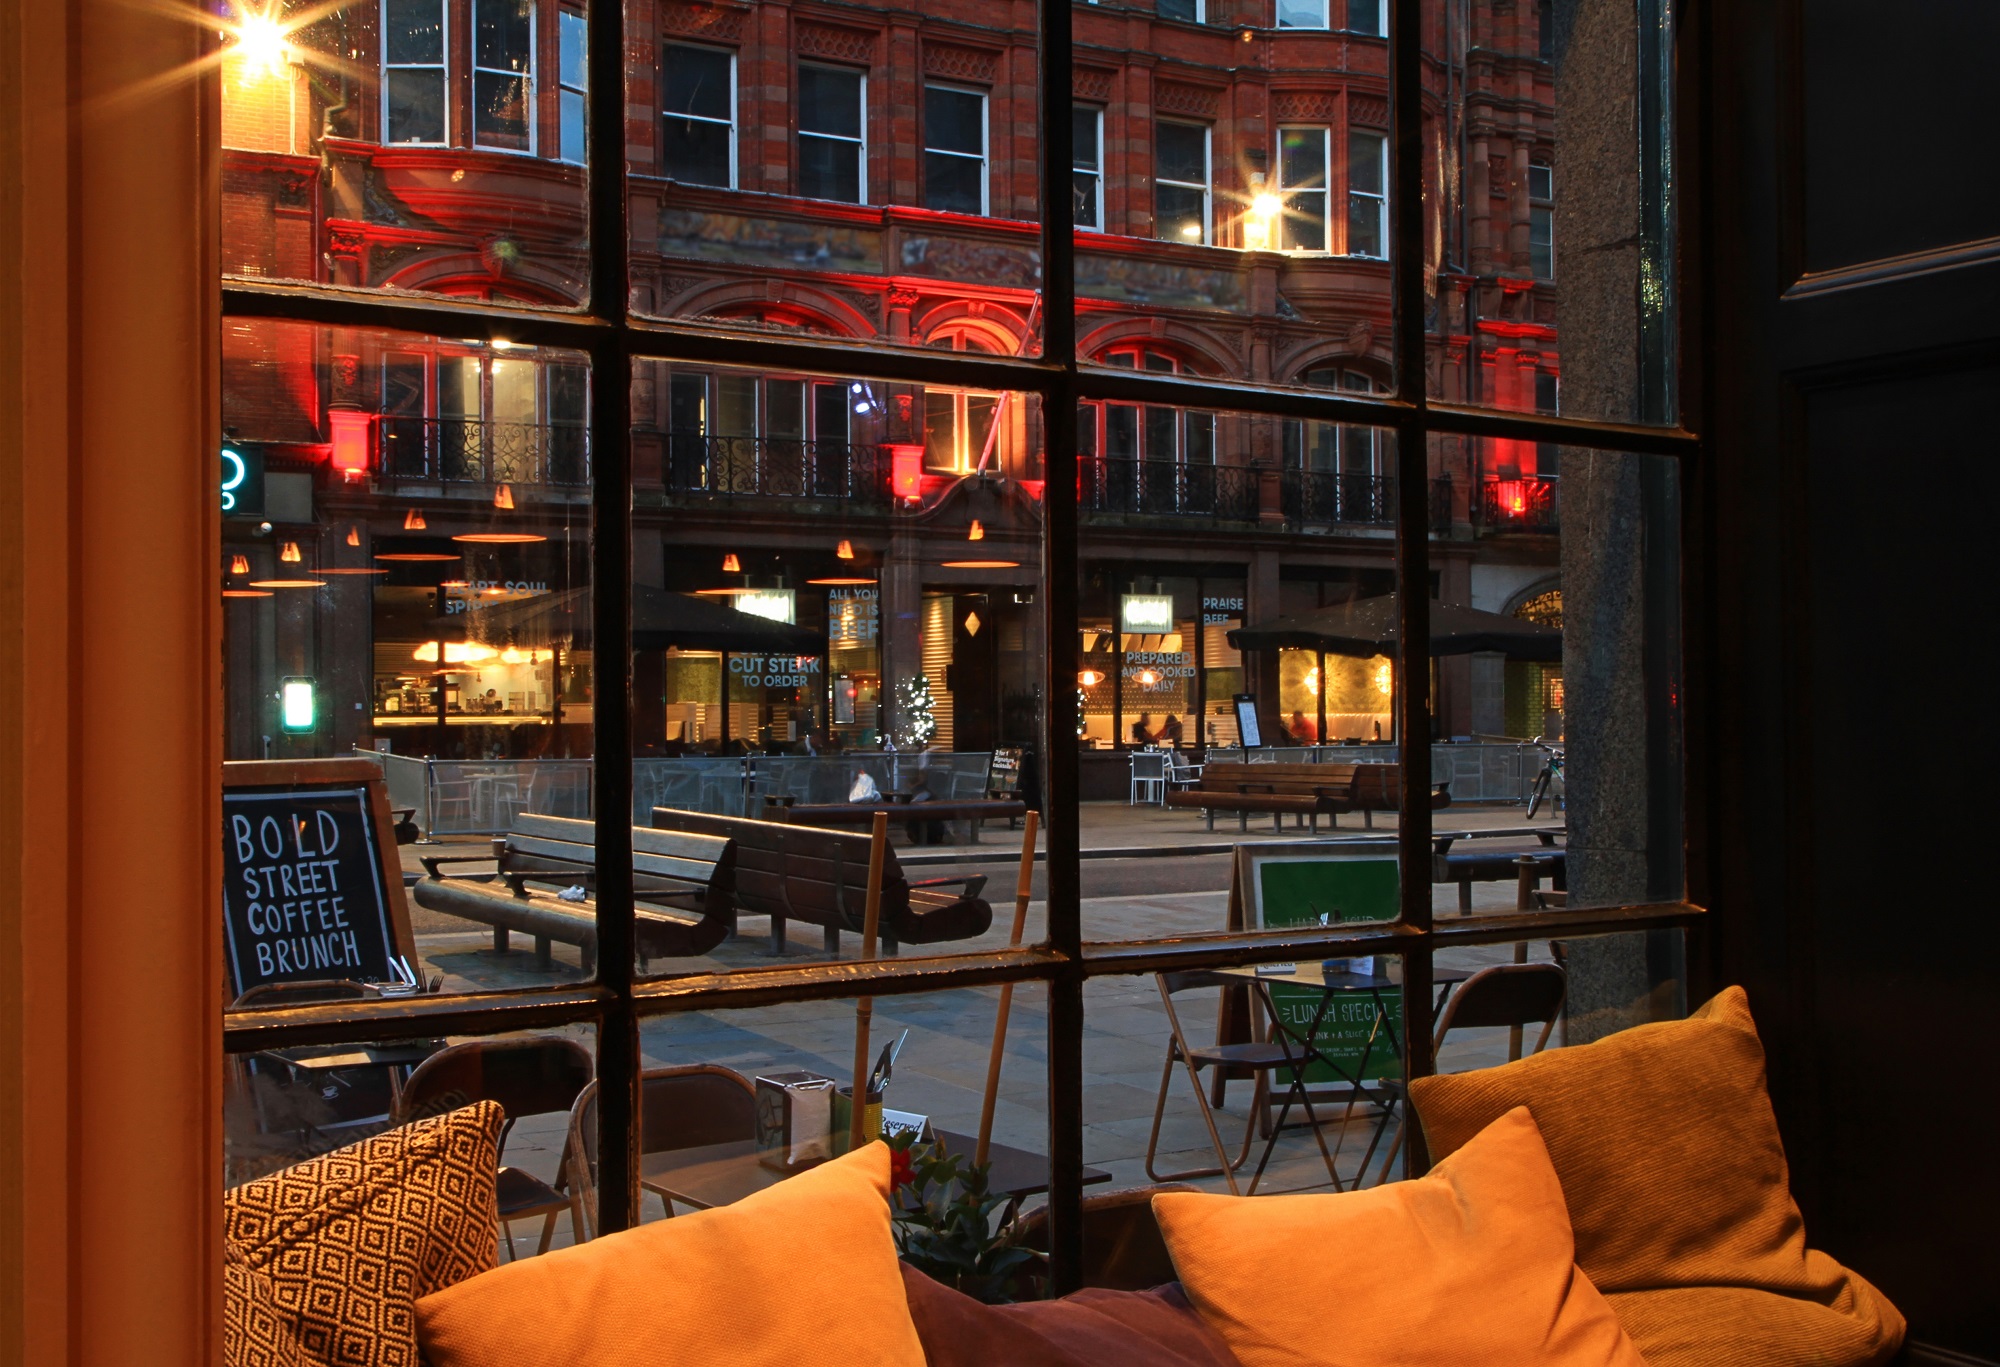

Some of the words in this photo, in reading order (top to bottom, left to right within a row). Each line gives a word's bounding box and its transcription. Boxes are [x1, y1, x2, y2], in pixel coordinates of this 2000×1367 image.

[505, 581, 547, 595] SOUL
[829, 589, 850, 601] ALL
[854, 590, 879, 601] YOU
[829, 604, 863, 617] NEED
[867, 604, 879, 616] IS
[1203, 597, 1244, 610] PRAISE
[1203, 614, 1229, 626] BEEF
[829, 619, 879, 640] BEEF
[1127, 651, 1192, 665] PREPARED
[729, 658, 764, 673] CUT
[768, 658, 820, 674] STEAK
[742, 675, 760, 687] TO
[764, 675, 808, 688] ORDER
[1143, 680, 1175, 693] DAILY
[232, 809, 340, 864] BOLD
[243, 859, 340, 900] STREET
[247, 896, 350, 936] COFFEE
[256, 930, 361, 977] BRUNCH
